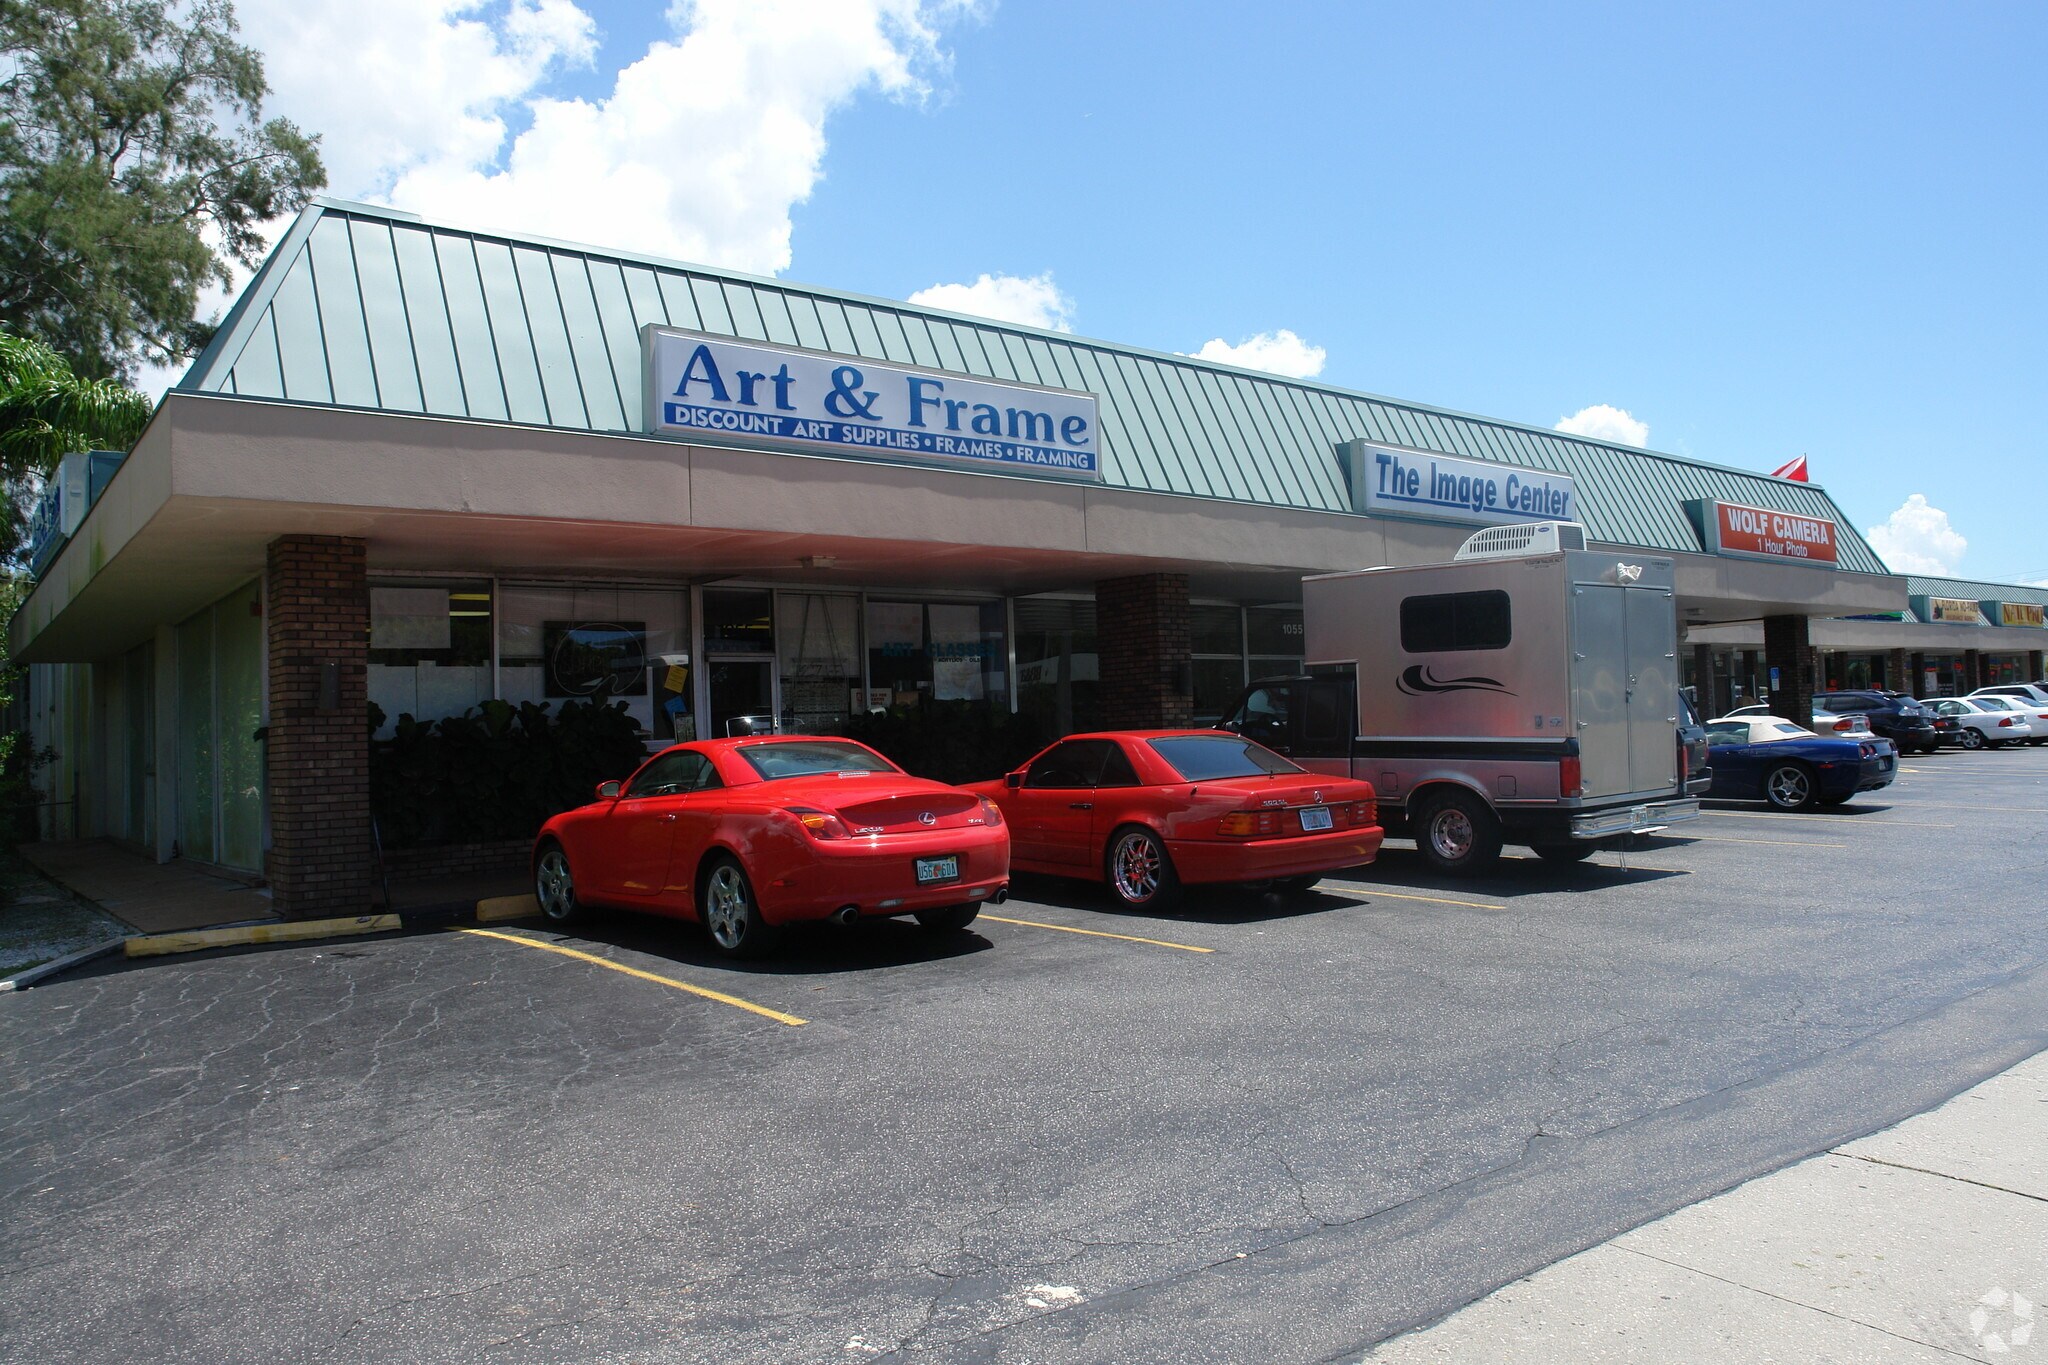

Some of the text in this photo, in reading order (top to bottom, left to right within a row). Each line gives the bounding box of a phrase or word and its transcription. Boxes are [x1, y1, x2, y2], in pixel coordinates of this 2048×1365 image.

[672, 344, 1090, 447] Art & Frame
[675, 406, 1090, 469] DISCOUNT ART SUPPLIES FRAMES FRAMING
[1375, 453, 1570, 516] The Image Center
[1726, 507, 1830, 545] WOLF CAMERA
[1757, 537, 1808, 558] 1 Hour Photo
[1282, 623, 1303, 635] 1055
[882, 640, 996, 658] ART CLASSES
[918, 865, 933, 879] U56
